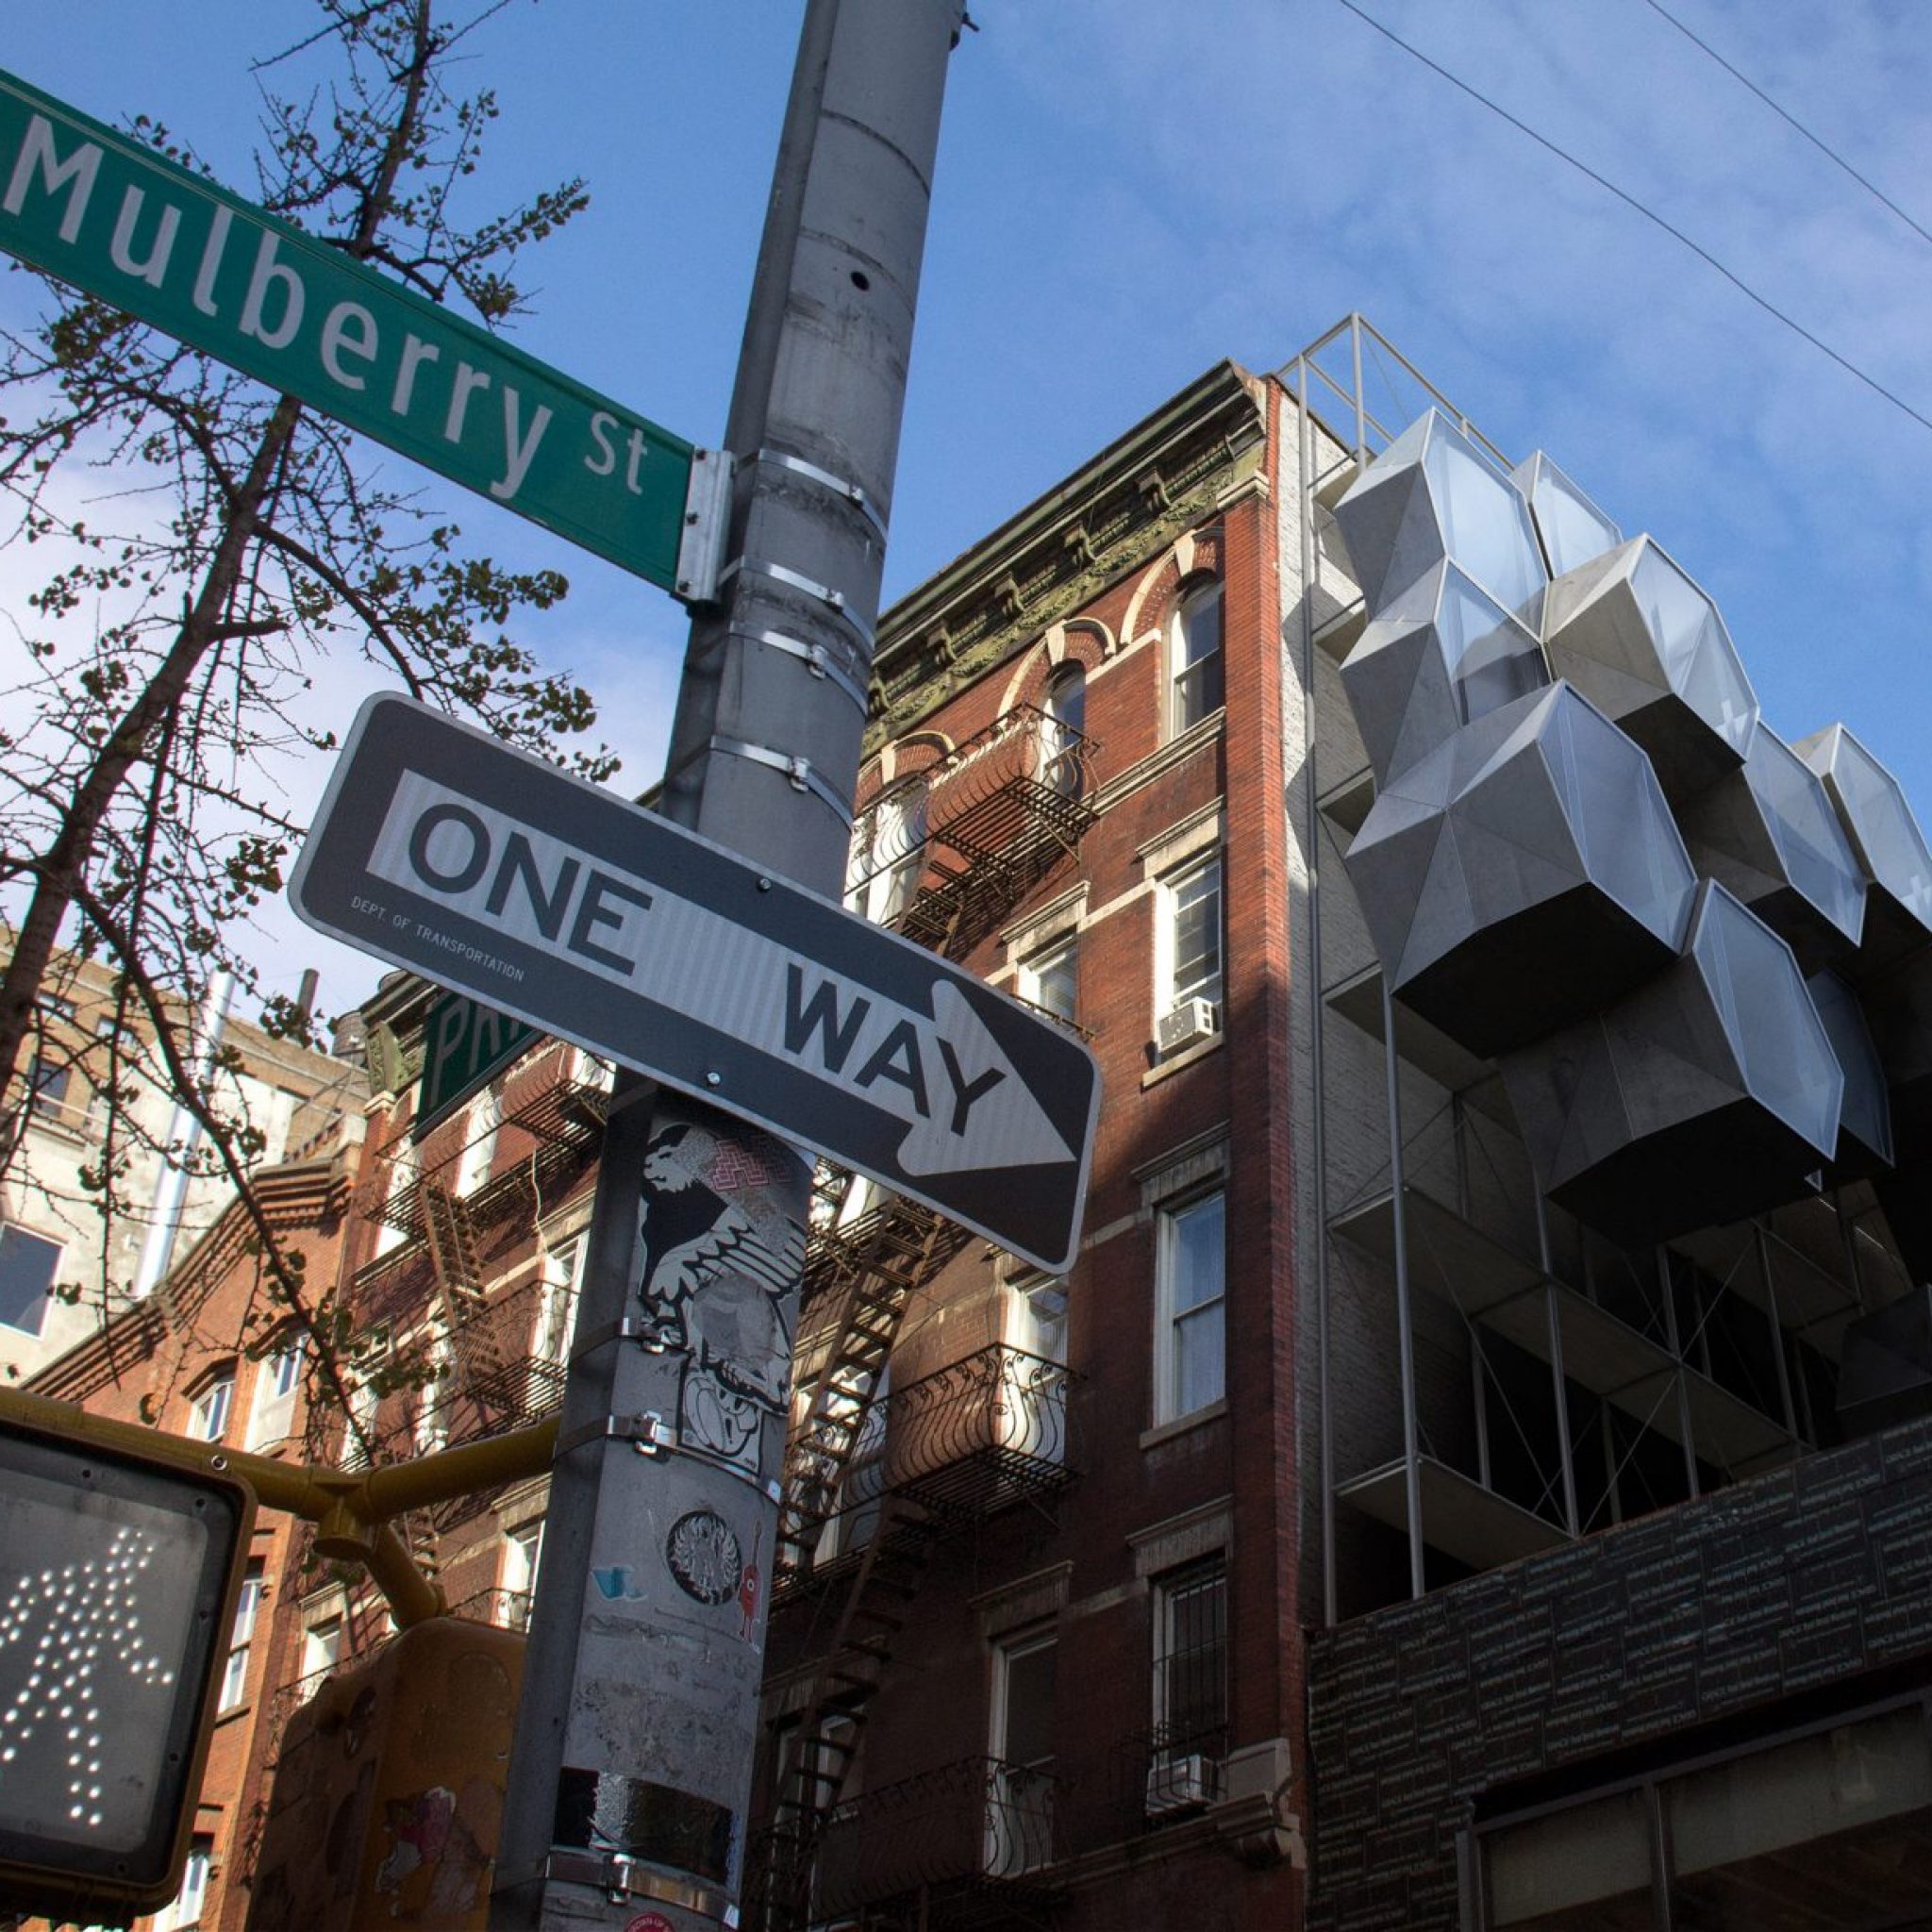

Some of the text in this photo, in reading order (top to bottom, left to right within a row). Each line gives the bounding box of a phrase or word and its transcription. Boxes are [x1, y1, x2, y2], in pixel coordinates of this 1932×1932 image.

[3, 113, 648, 500] Mulberry St
[351, 895, 525, 982] DEPT. OF TRANSPORTATION
[408, 803, 1007, 1138] ONE WAY
